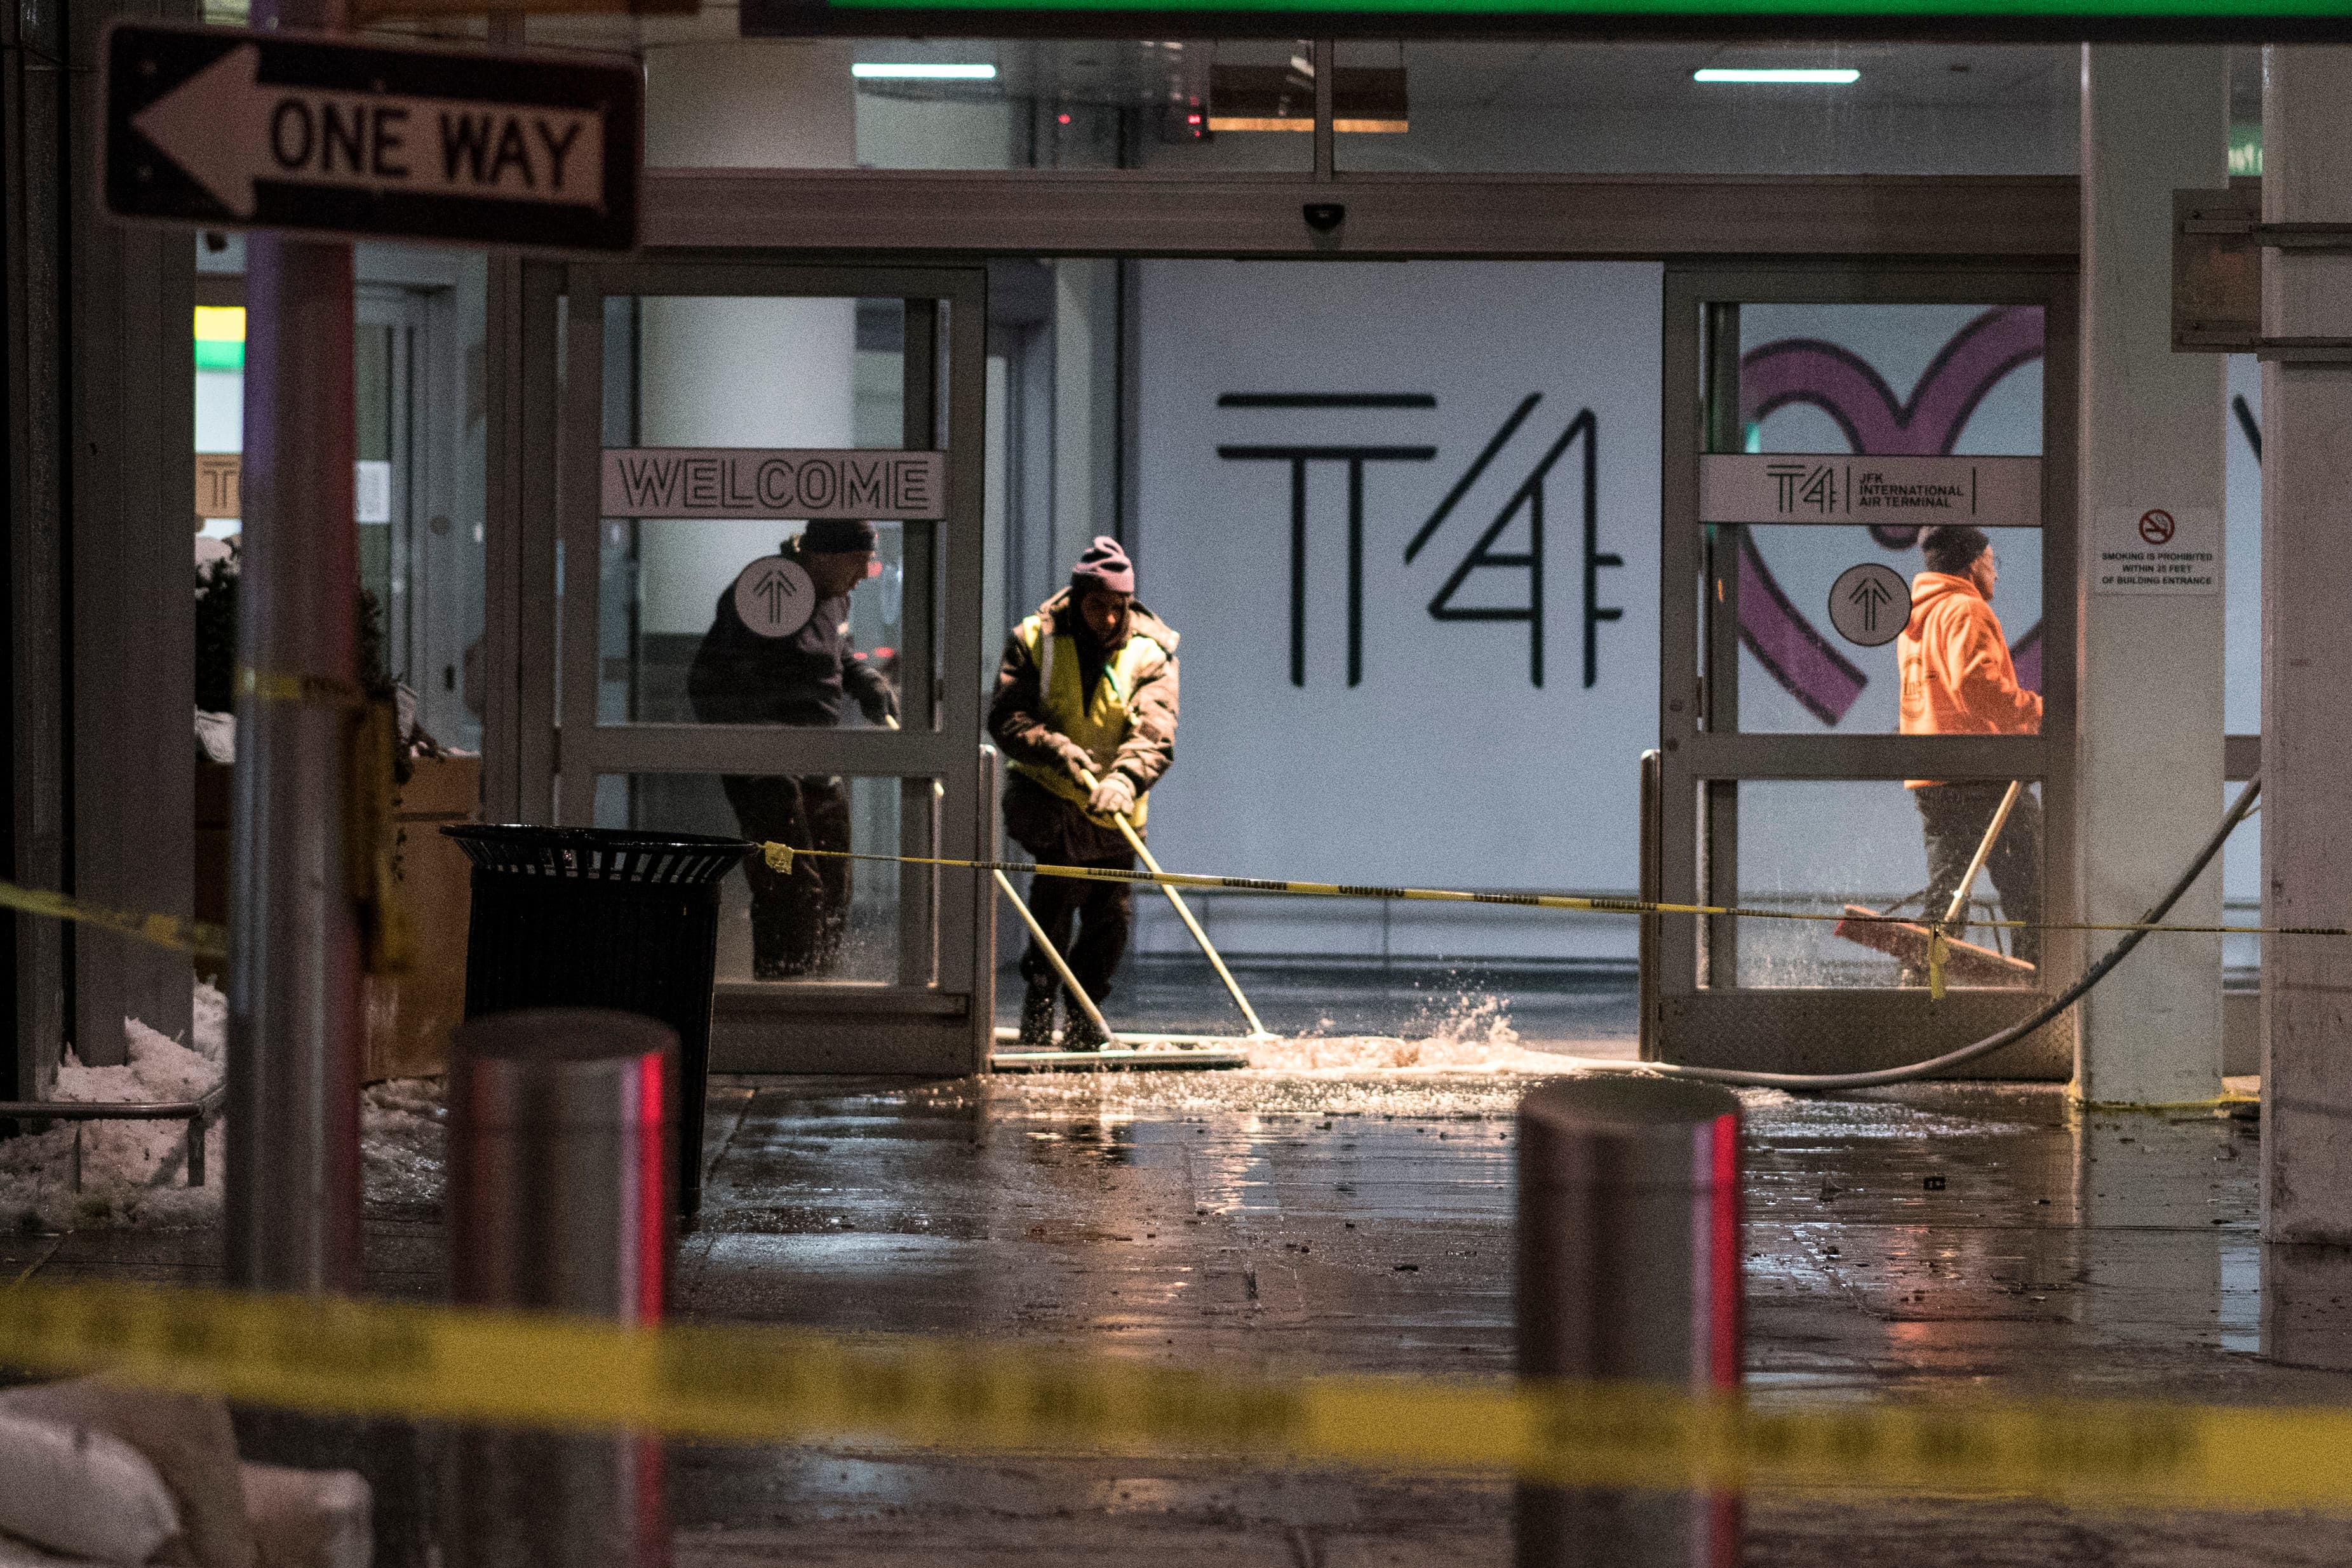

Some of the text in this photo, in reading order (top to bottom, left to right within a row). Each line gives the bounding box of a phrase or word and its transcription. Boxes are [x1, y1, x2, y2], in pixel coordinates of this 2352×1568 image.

[271, 98, 582, 191] ONE WAY
[618, 457, 929, 510] WELCOME
[1859, 473, 1883, 484] JFK
[1767, 464, 1836, 513] T4
[1859, 485, 1964, 497] INTERNATIONAL
[1859, 496, 1951, 509] AIR TERMINAL
[1217, 392, 1623, 688] T4
[2102, 552, 2213, 561] SMOKING IS PROHIBITED
[2122, 564, 2154, 573] WITHIN
[2169, 565, 2192, 573] FEET
[2102, 576, 2212, 586] OF BUILDING ENTRANCE
